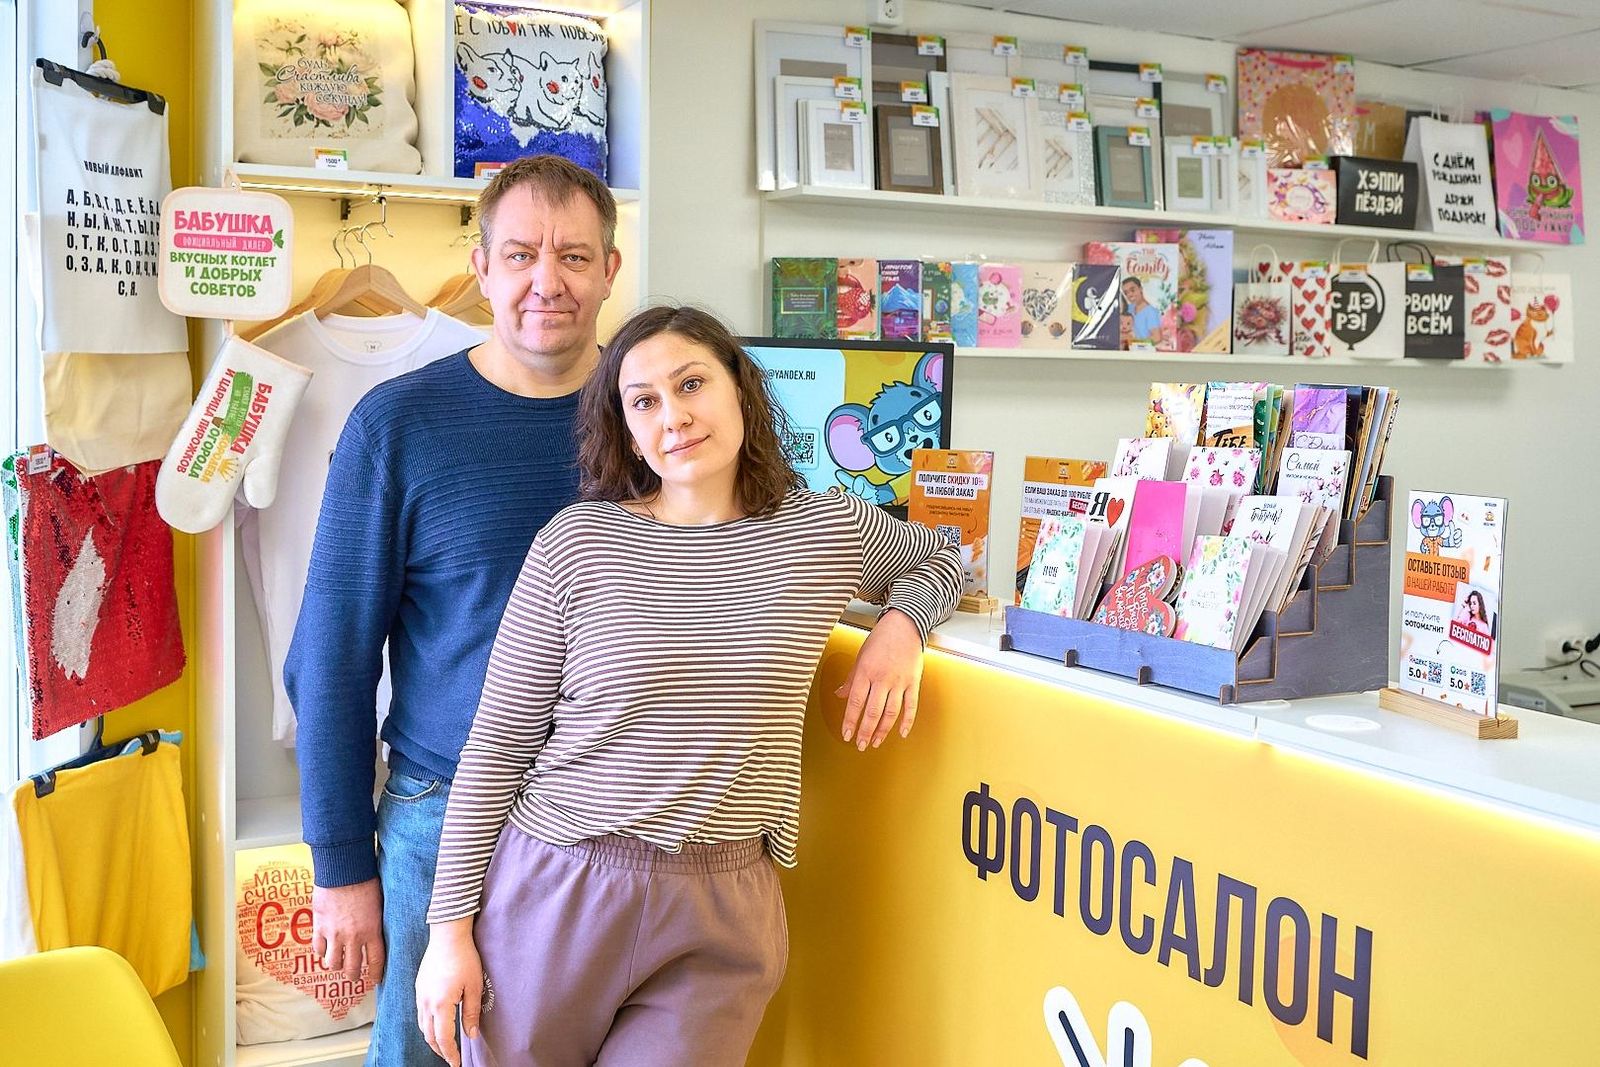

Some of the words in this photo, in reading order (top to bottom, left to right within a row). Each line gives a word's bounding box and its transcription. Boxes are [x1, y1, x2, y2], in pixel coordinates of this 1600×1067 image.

[529, 22, 554, 38] ТАК
[84, 160, 109, 174] НОВЫЙ
[111, 166, 143, 178] АЛФАВИТ
[1434, 152, 1439, 166] С
[1442, 153, 1475, 170] ДНЁМ
[1357, 170, 1404, 193] ХЭППИ
[1355, 192, 1403, 216] ПЁЗДЭЙ
[1444, 193, 1474, 205] ДЕРЖИ
[174, 211, 273, 234] БАБУШКА
[1438, 208, 1486, 225] ПОДАРОК!
[183, 236, 237, 249] ОФИЦИАЛЬНЫЙ
[242, 240, 266, 251] ДИЛЕР
[170, 252, 227, 265] ВКУСНЫХ
[231, 255, 276, 267] КОТЛЕТ
[1126, 256, 1169, 280] Family
[185, 266, 195, 278] И
[200, 267, 262, 281] ДОБРЫХ
[190, 282, 256, 297] СОВЕТОВ
[1330, 291, 1342, 309] С
[1347, 291, 1376, 313] ДЭ
[1336, 312, 1367, 332] РЭ!
[1406, 312, 1452, 335] ВСЁМ
[226, 368, 236, 378] И
[204, 377, 231, 418] ЦАРИЦА
[230, 382, 272, 454] БАБУШКА
[176, 416, 210, 474] ПИРОЖКОВ
[188, 427, 220, 479] ОГОРОДА
[918, 474, 946, 483] ПОЛУЧИТЕ
[948, 476, 970, 485] СКИДКУ
[926, 486, 934, 495] НА
[935, 486, 955, 496] ЛЮБОЙ
[956, 488, 974, 497] ЗАКАЗ
[1047, 488, 1060, 496] ЗАКАЗ
[1077, 491, 1092, 499] РУБЛЕ
[1089, 492, 1110, 516] Я
[1408, 558, 1440, 576] ОСТАВЬТЕ
[1442, 563, 1467, 580] ОТЗЫВ
[1411, 576, 1432, 592] НАШЕЙ
[1432, 579, 1455, 596] РАБОТЕ
[1404, 620, 1444, 634] ФОТОМАГНИТ
[1452, 625, 1490, 652] БЕСПЛАТНО
[1408, 667, 1421, 678] 5.0
[1450, 678, 1464, 690] 5.0
[254, 869, 311, 887] мама
[244, 881, 314, 905] счасть
[289, 895, 312, 906] пом
[961, 781, 1374, 1061] ФОТОСАЛОН
[255, 948, 290, 967] дети
[293, 971, 346, 985] взаимопо
[315, 979, 365, 999] папа
[330, 996, 355, 1015] уют
